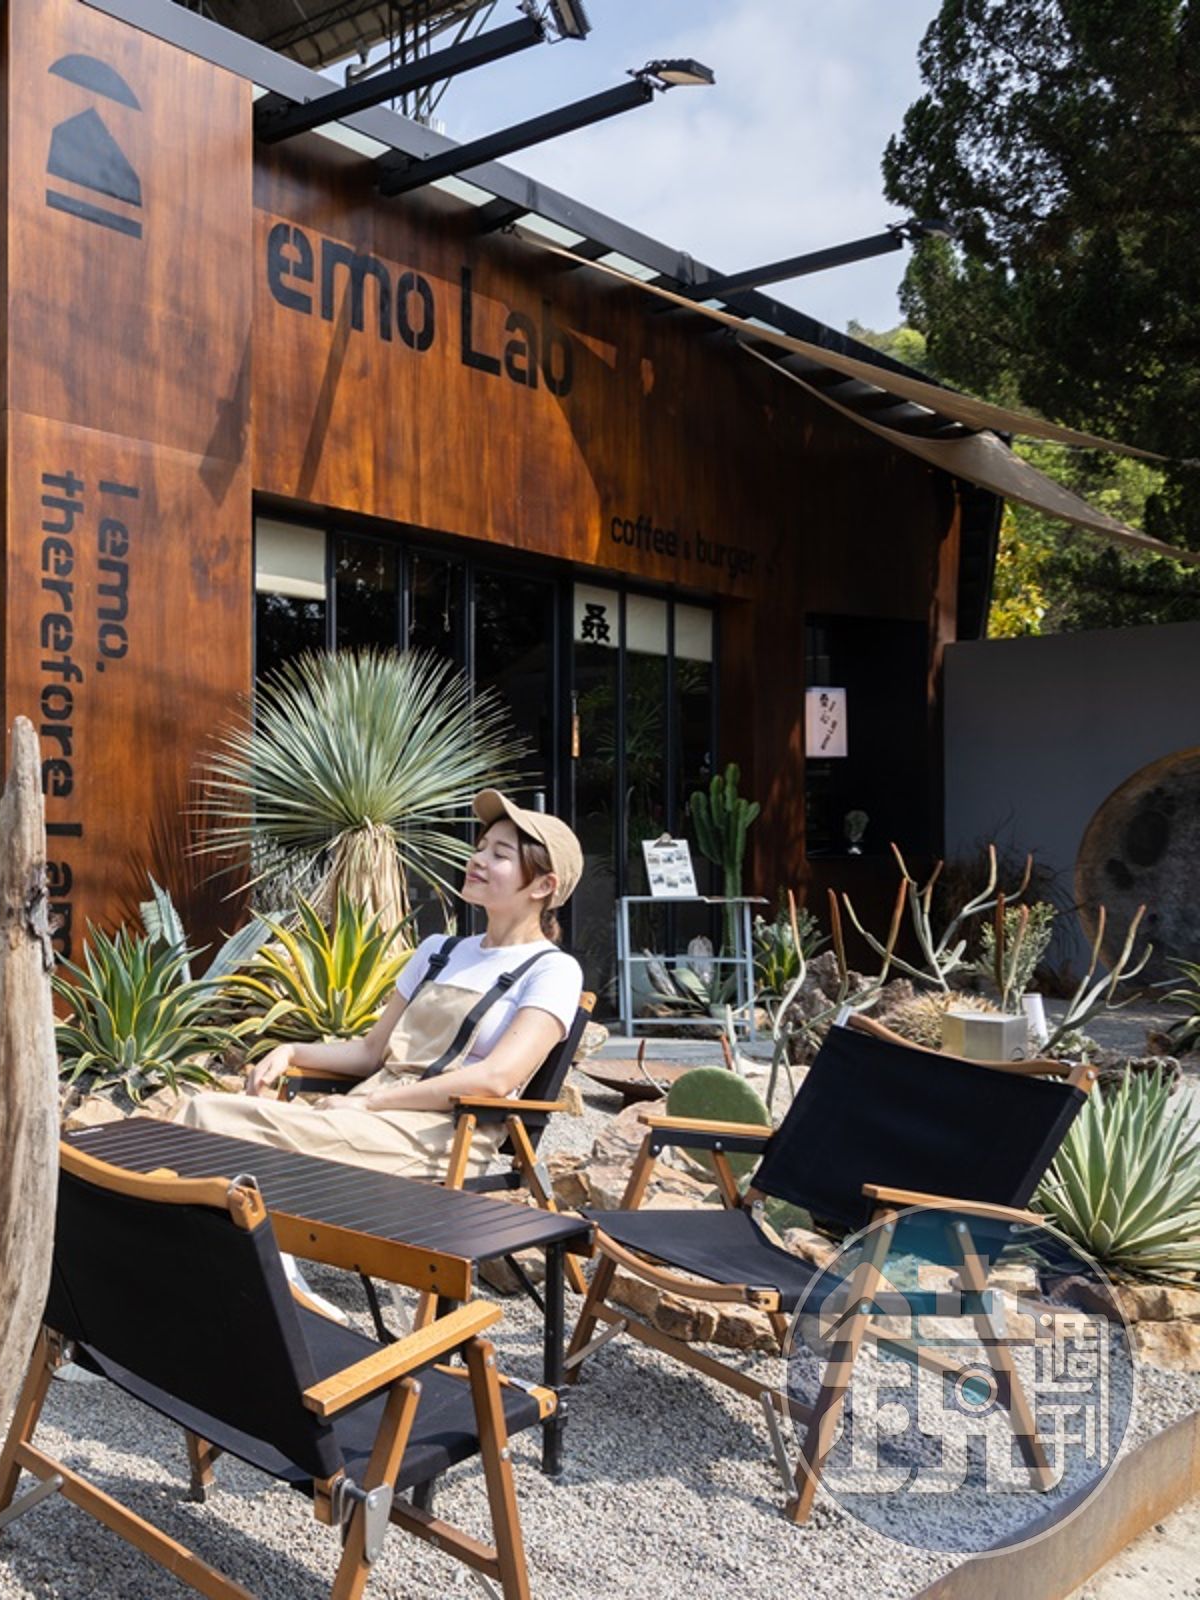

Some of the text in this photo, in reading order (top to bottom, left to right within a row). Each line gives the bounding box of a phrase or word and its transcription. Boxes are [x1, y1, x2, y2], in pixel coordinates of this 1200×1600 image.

[267, 222, 575, 397] emo Lab
[40, 470, 85, 798] therefore
[96, 479, 140, 673] I emo.
[610, 514, 678, 558] coffee
[696, 530, 757, 579] burger
